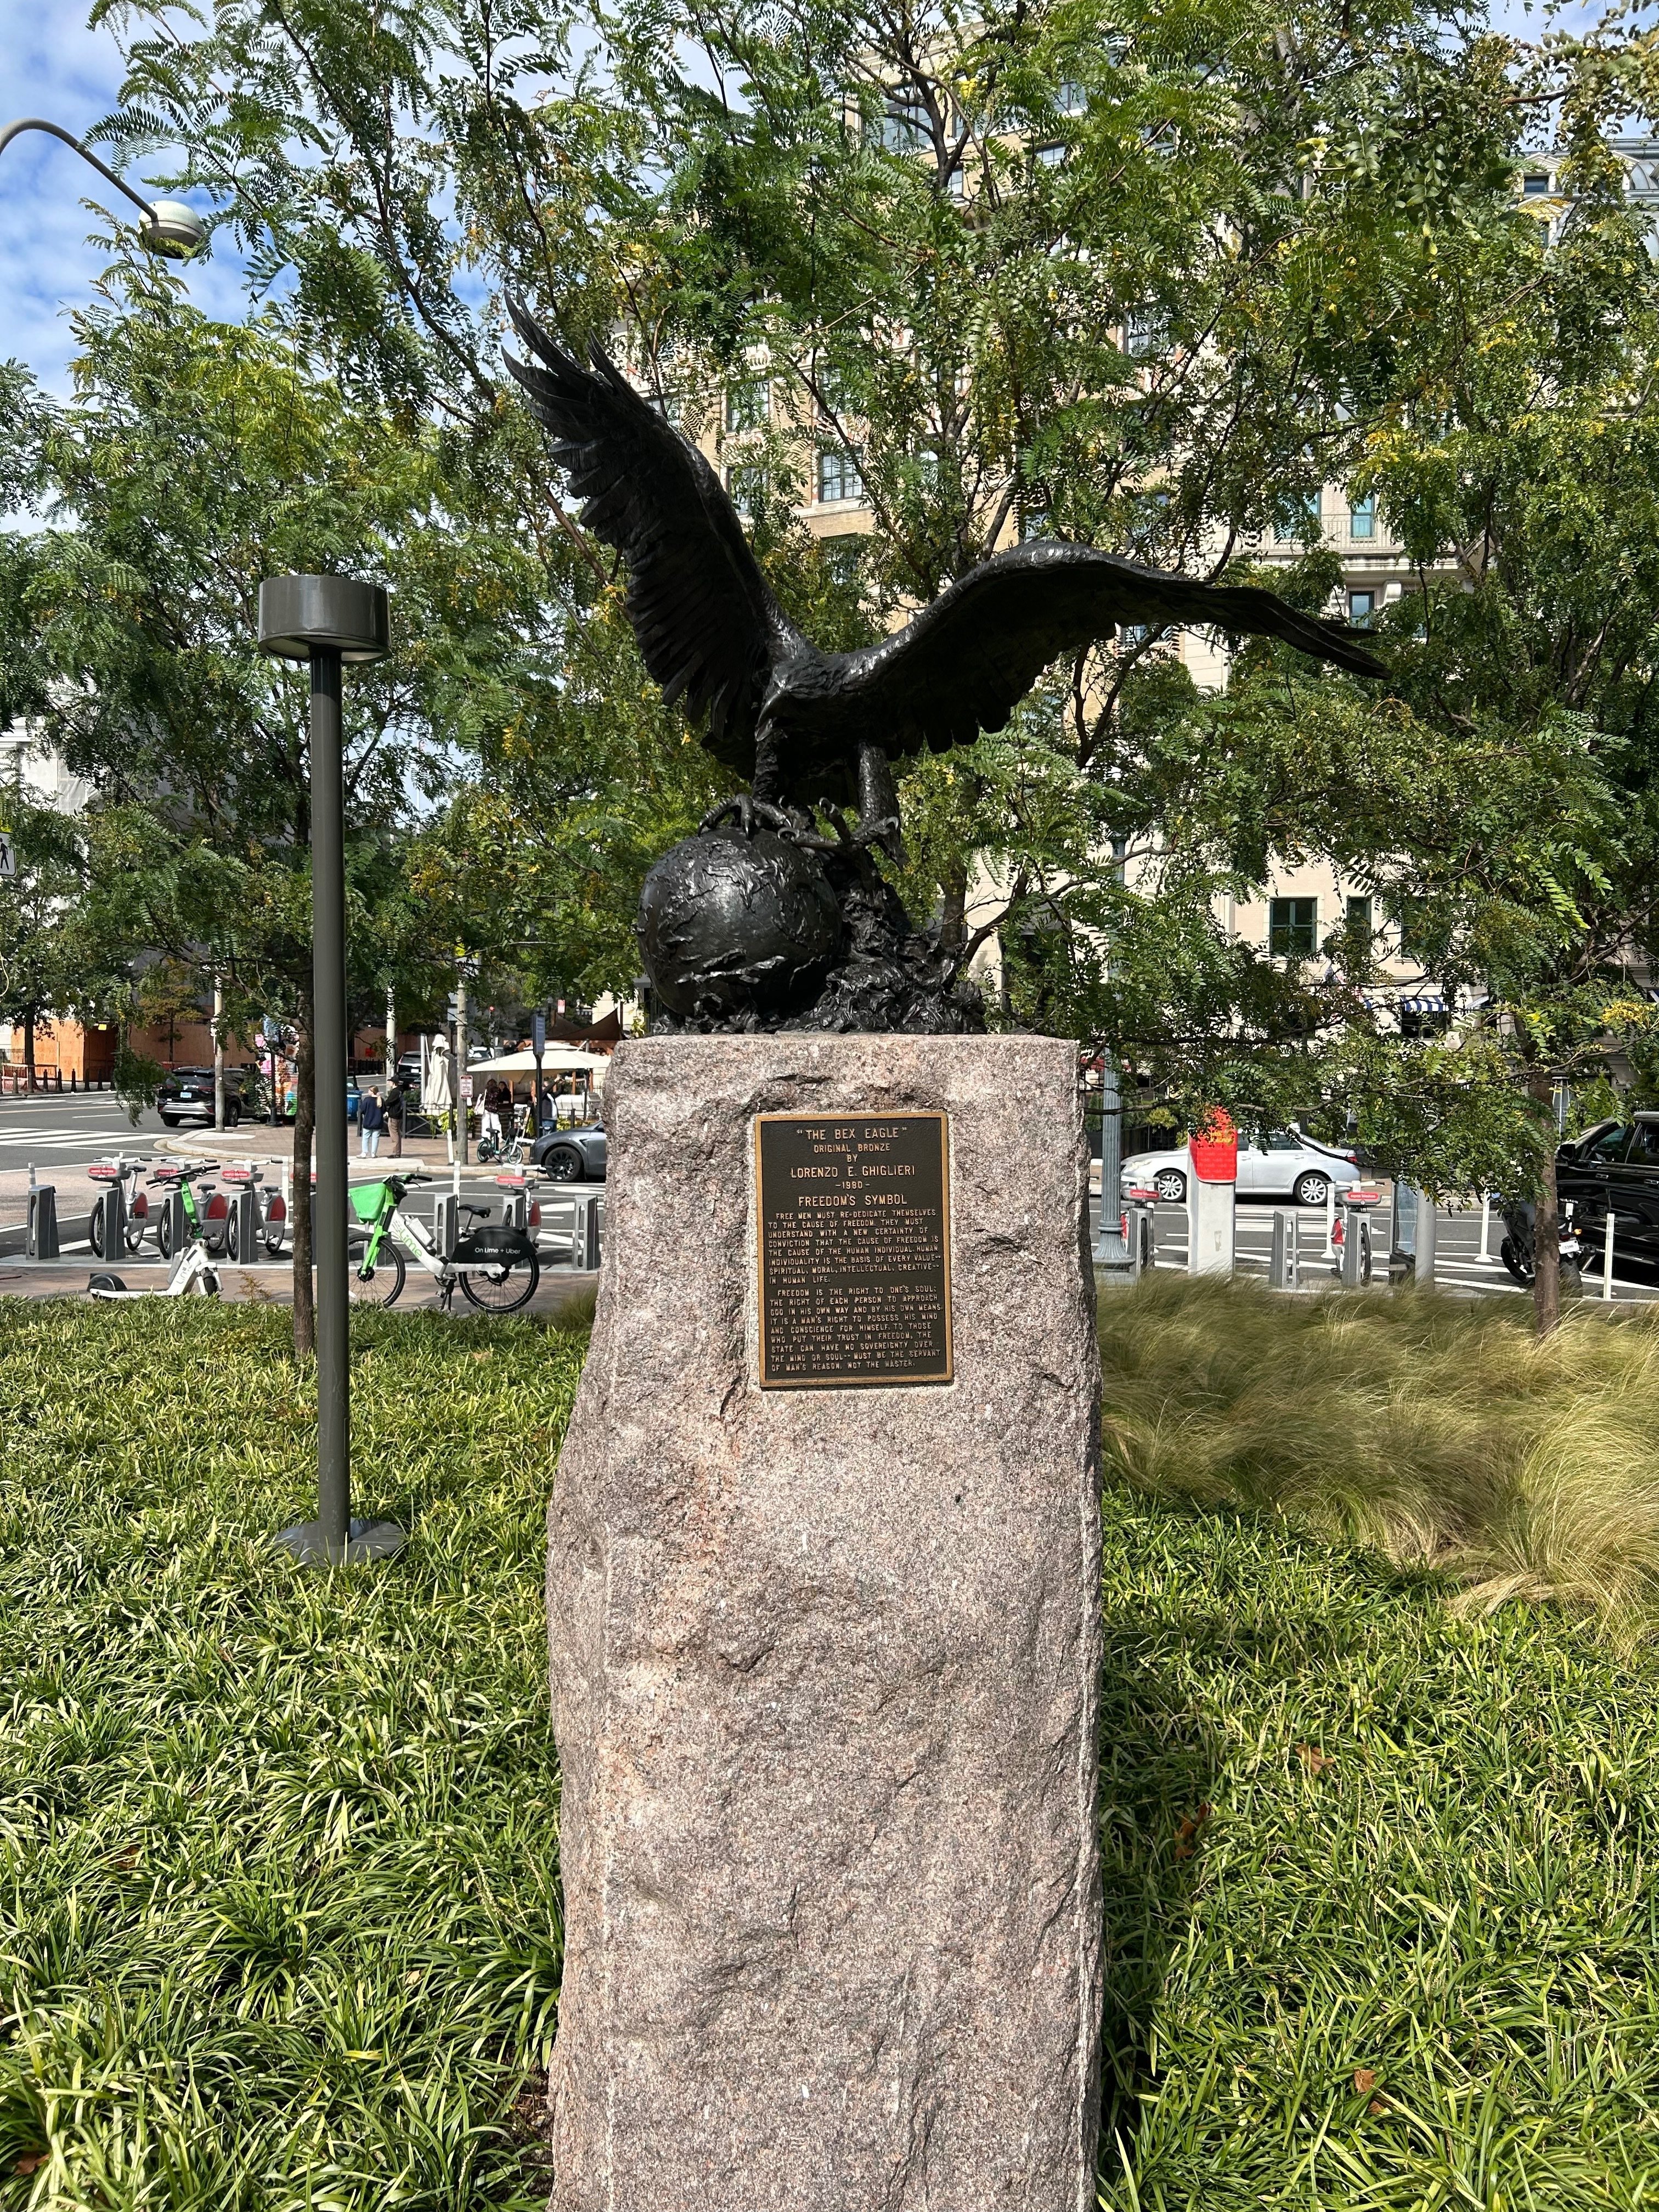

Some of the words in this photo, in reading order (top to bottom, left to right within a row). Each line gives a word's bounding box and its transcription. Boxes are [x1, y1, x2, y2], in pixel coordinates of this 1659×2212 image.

[797, 1129, 826, 1141] "THE
[835, 1130, 855, 1139] BEX
[865, 1127, 907, 1138] EAGLE"
[814, 1144, 851, 1153] ORIGINAL
[858, 1143, 890, 1152] BRONZE
[847, 1154, 858, 1163] BY
[791, 1167, 838, 1178] LORENZO
[862, 1166, 915, 1176] GHIGLIERI
[799, 1194, 856, 1207] FREEDOM'S
[865, 1194, 907, 1206] SYMBOL
[769, 1239, 810, 1248] CONVICTION
[769, 1258, 819, 1266] INDIVIDUALITY
[890, 1285, 909, 1294] ONE'S
[802, 1316, 822, 1324] MAN'S
[860, 1342, 908, 1350] SOVEREIGNTY
[786, 1362, 806, 1371] MAN'S
